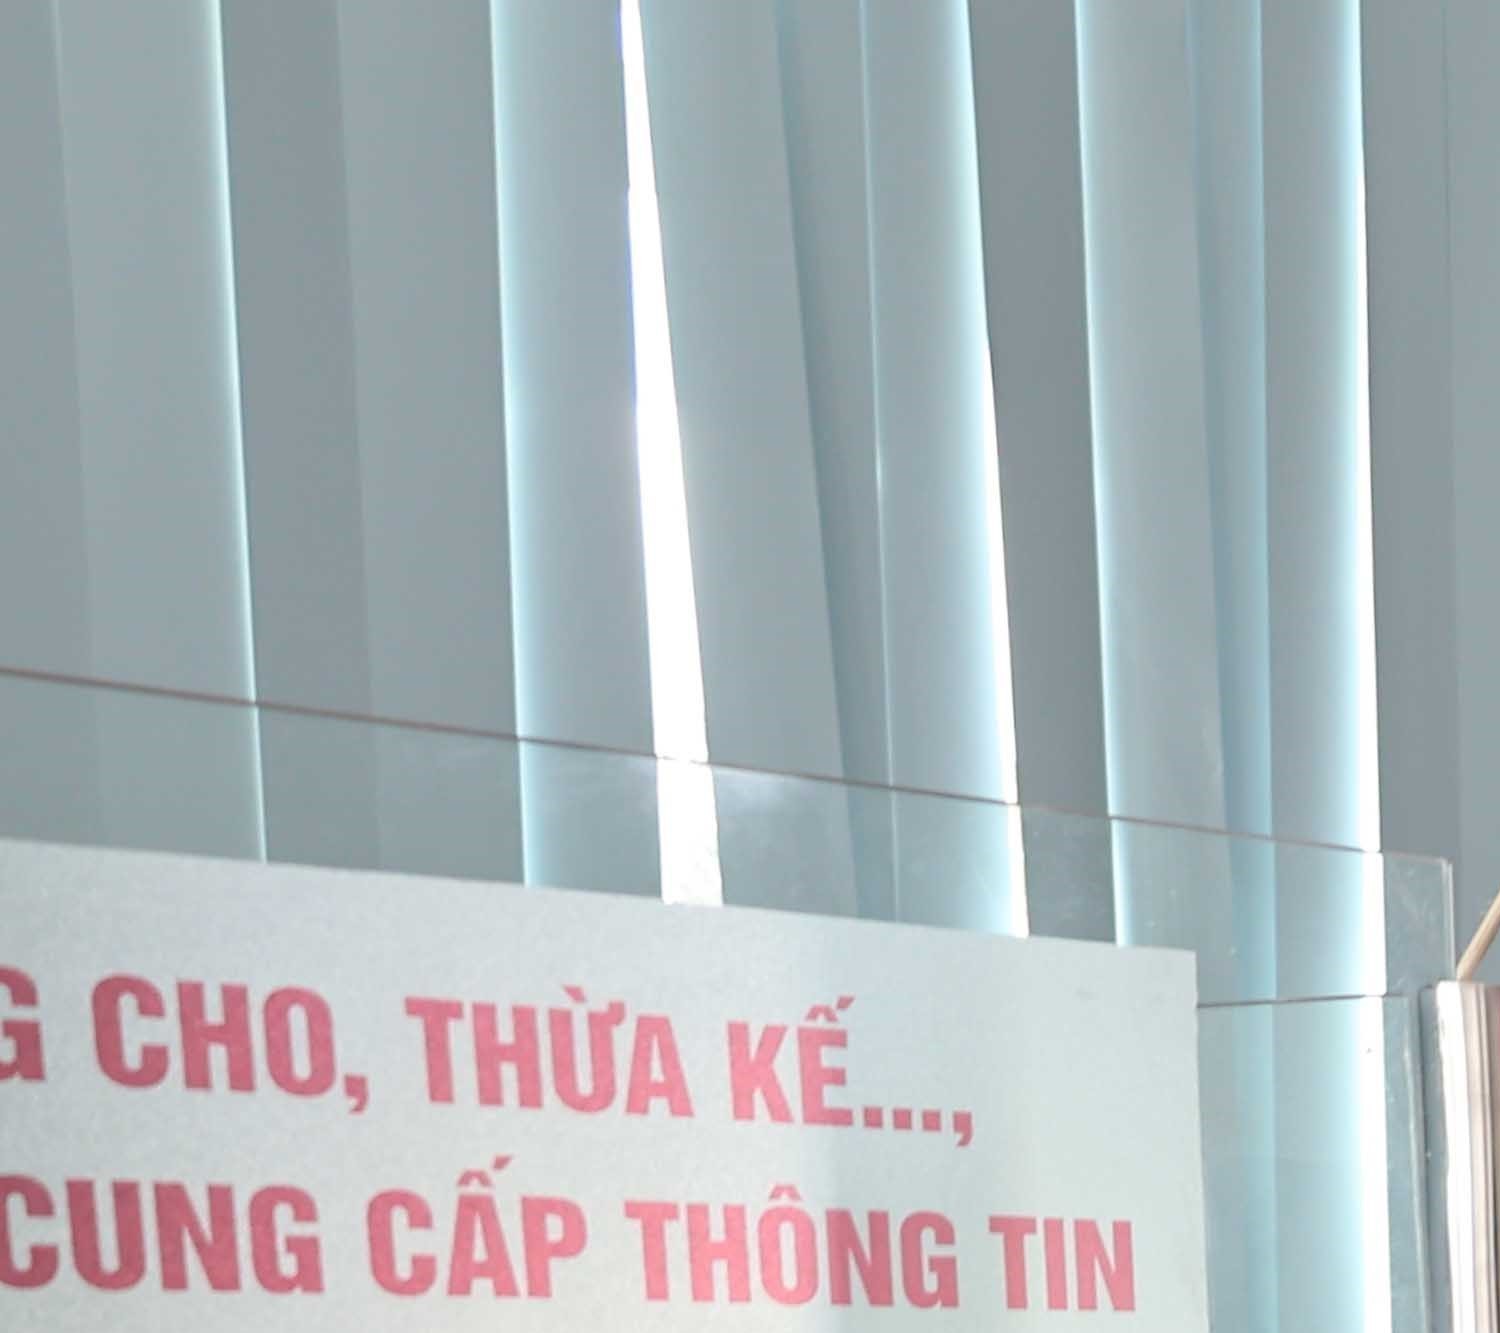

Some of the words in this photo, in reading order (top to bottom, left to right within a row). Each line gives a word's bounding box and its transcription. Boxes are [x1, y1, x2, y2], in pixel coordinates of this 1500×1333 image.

[91, 975, 368, 1115] CHO,
[405, 985, 693, 1118] THỪA
[0, 1172, 325, 1295] CUNG
[366, 1155, 589, 1299] CẤP
[625, 1184, 958, 1310] THÔNG
[990, 1214, 1135, 1312] TIN
